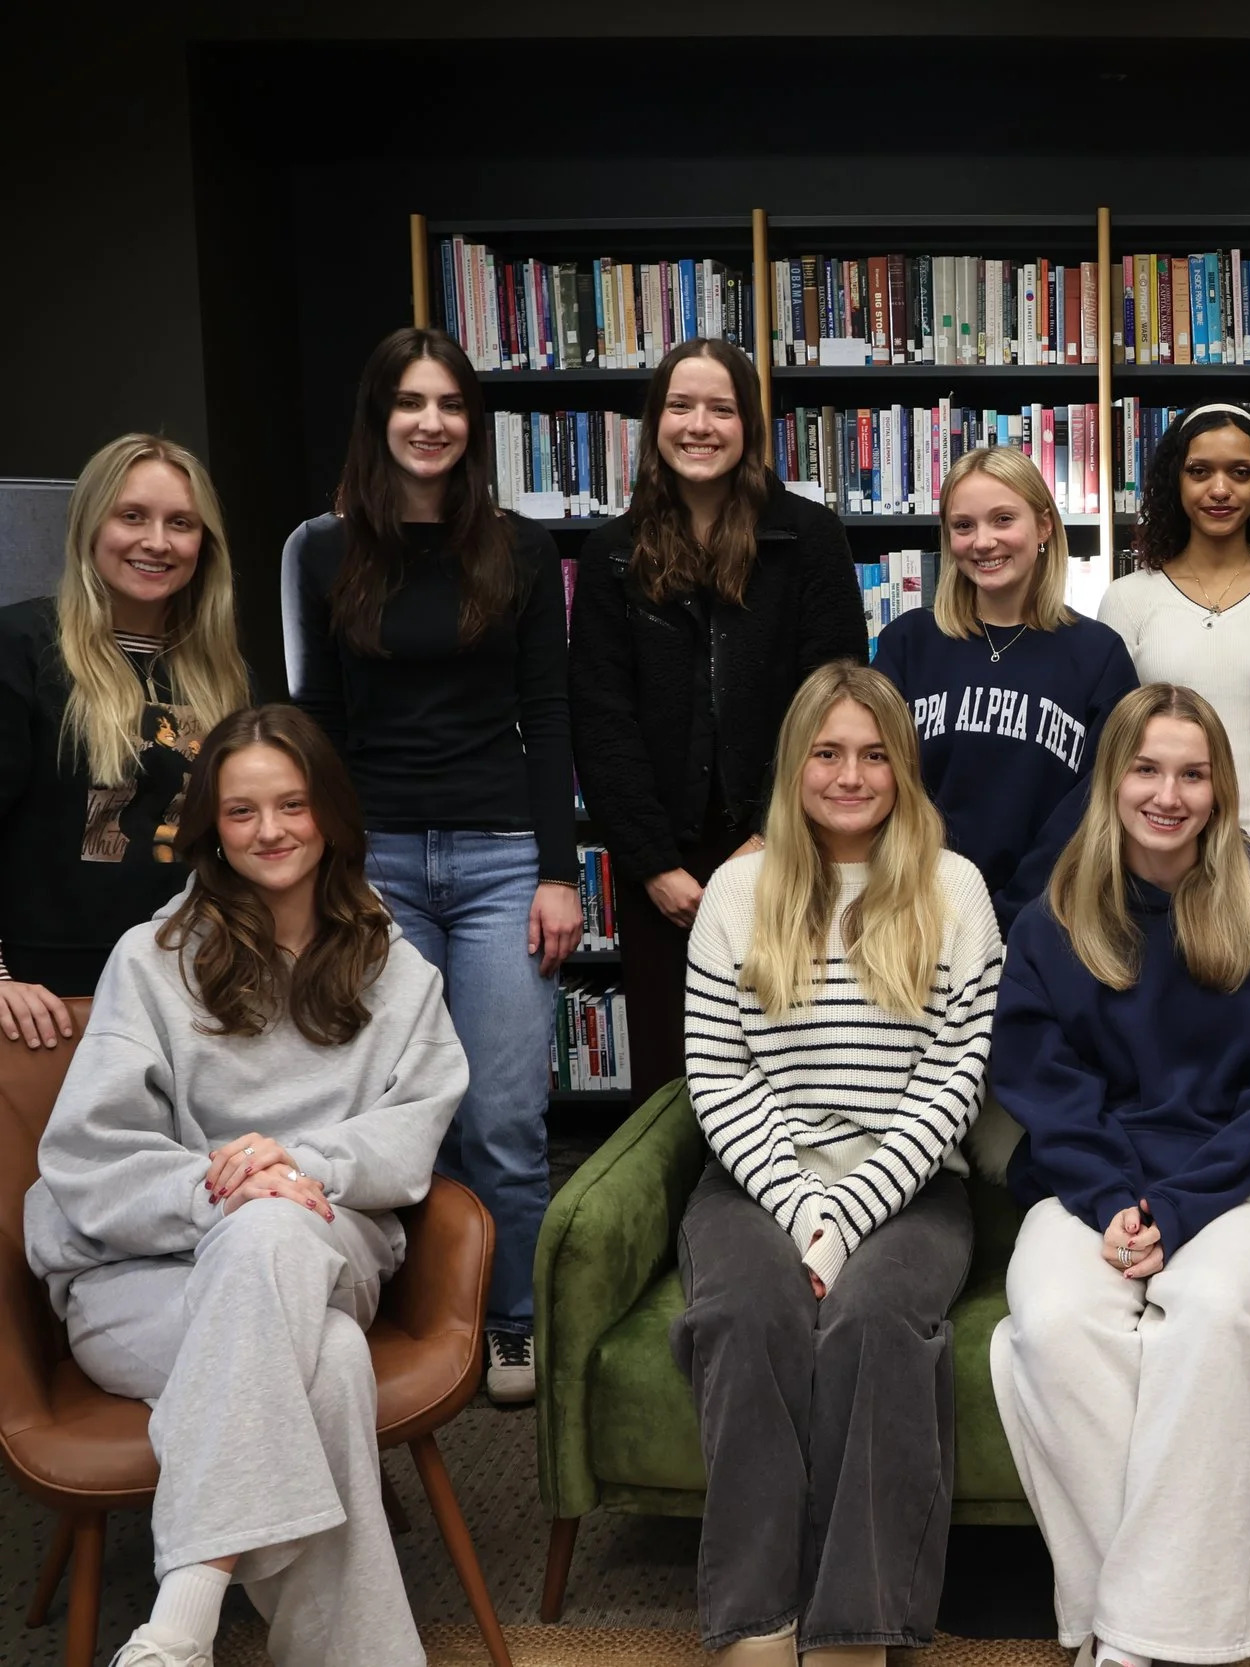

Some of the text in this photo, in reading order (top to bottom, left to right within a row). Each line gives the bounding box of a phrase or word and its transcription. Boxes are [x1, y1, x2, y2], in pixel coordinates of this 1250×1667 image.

[791, 268, 801, 305] OBAMA
[1194, 270, 1202, 289] INSIDE
[1196, 311, 1204, 325] TIME
[808, 425, 816, 449] PRIVACY
[907, 686, 1087, 774] PPA ALPHA THET
[582, 897, 587, 905] OF
